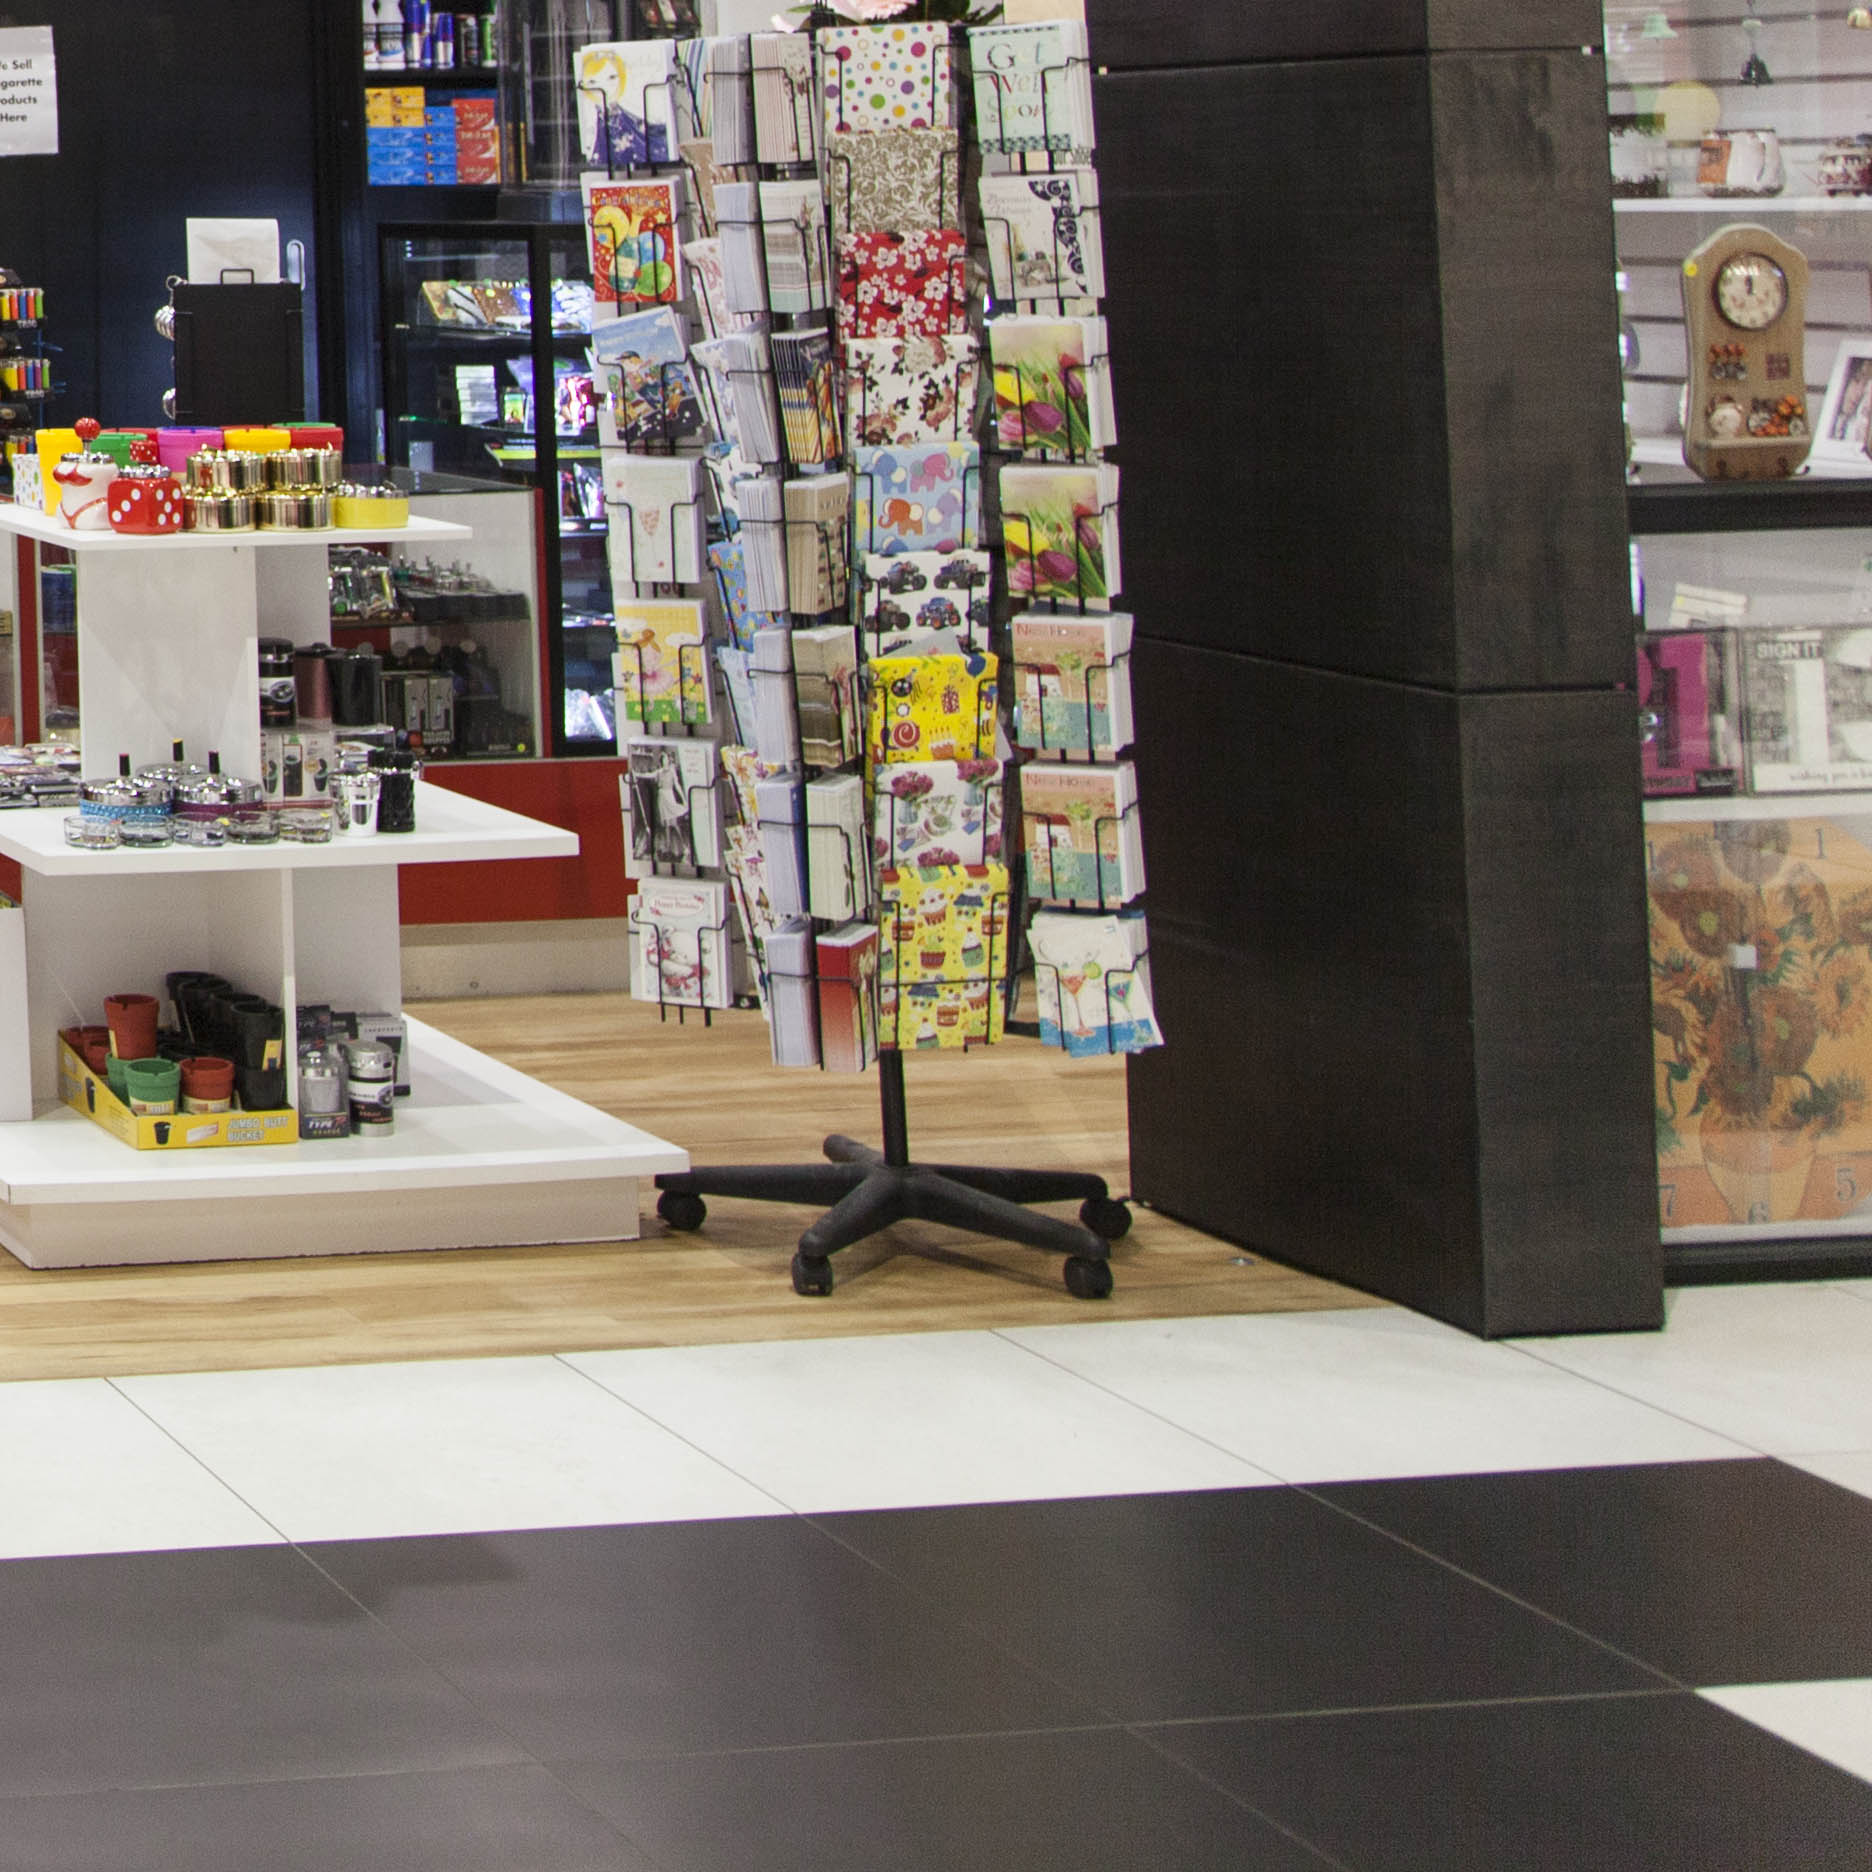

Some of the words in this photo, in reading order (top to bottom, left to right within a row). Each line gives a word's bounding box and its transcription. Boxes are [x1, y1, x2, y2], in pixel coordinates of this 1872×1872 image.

[13, 59, 33, 70] Sell
[0, 113, 27, 122] Here
[1757, 642, 1801, 659] SIGN
[227, 1118, 261, 1129] JUMBO
[263, 1116, 289, 1127] BUTT
[227, 1131, 265, 1142] BUCKET
